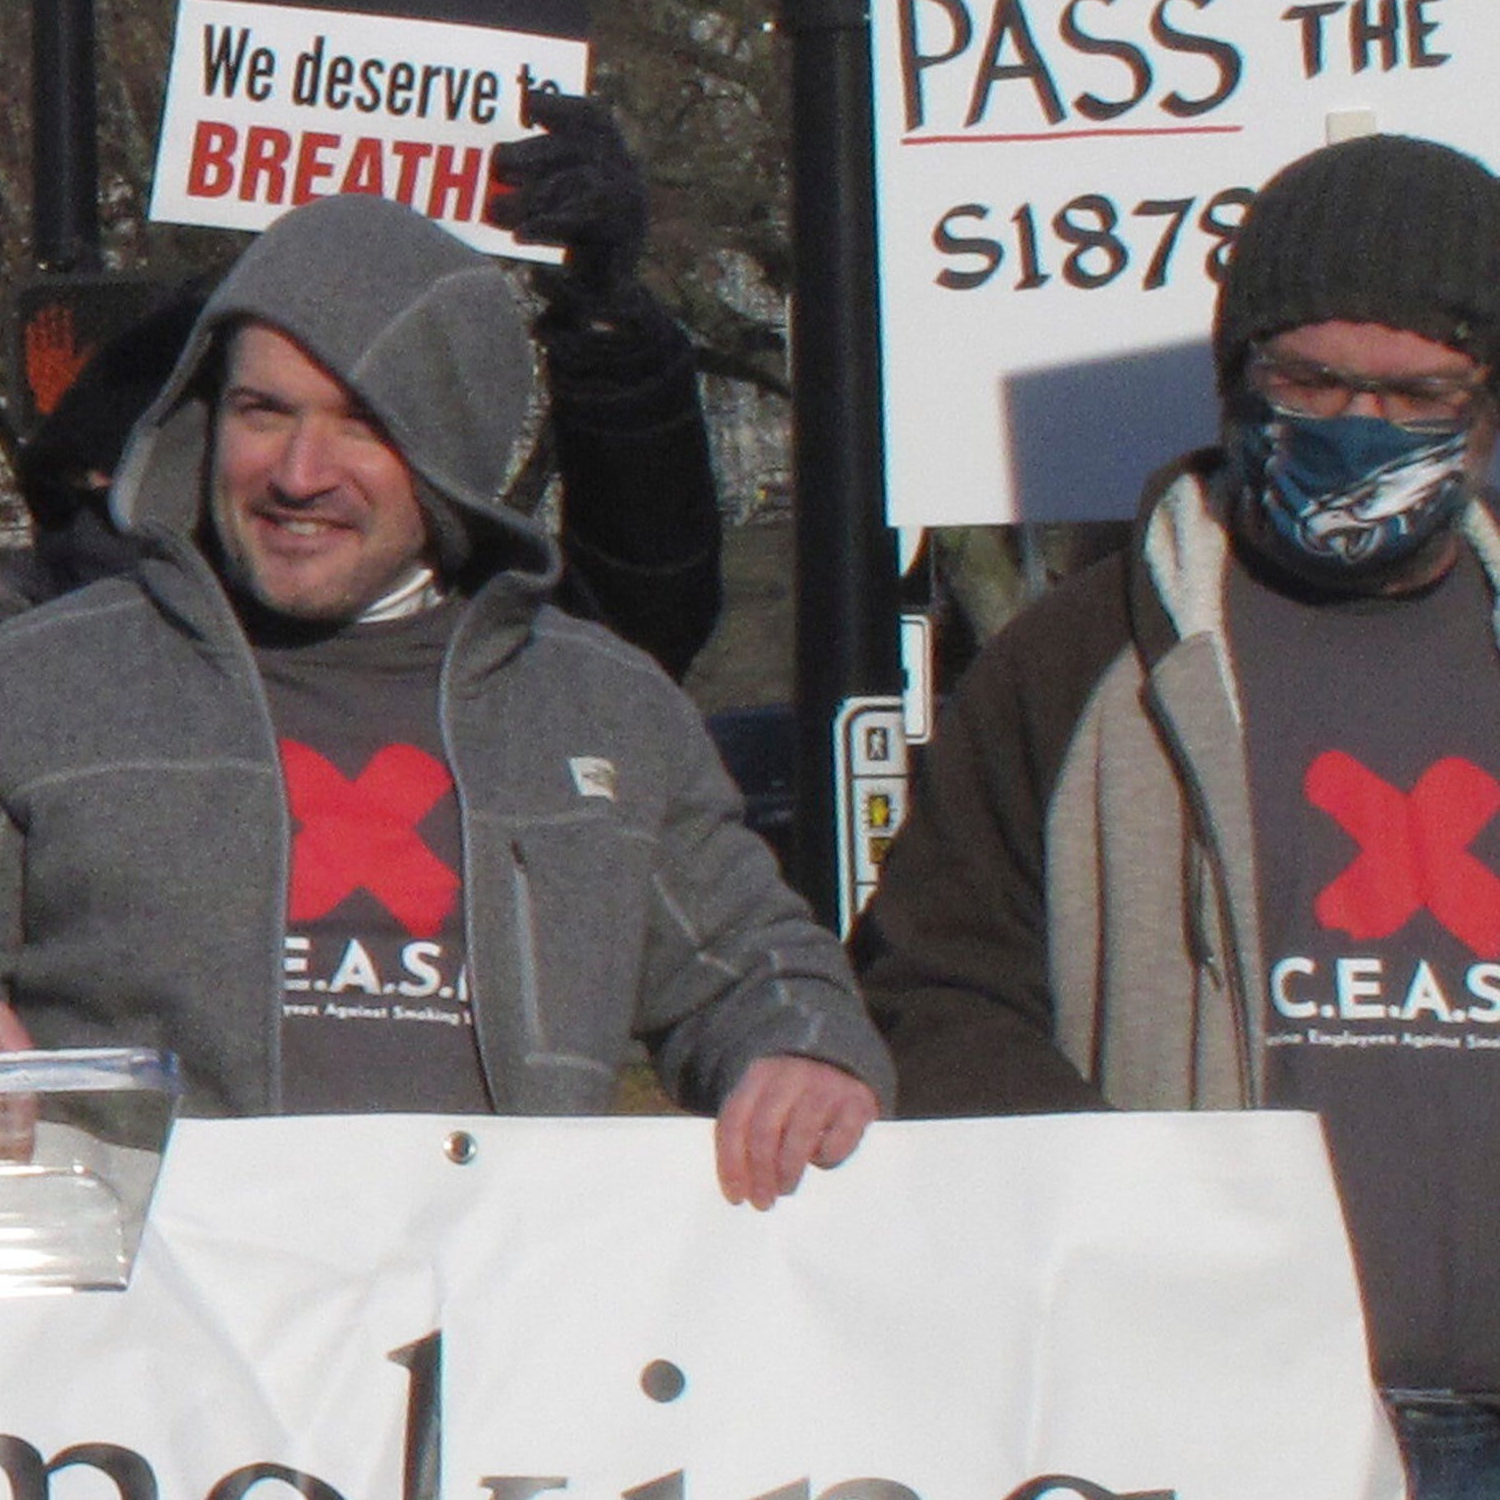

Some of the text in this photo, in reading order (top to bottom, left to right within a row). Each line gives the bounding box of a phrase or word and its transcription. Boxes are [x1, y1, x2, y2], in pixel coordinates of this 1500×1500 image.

[203, 23, 276, 102] We
[291, 35, 499, 126] deserve
[283, 936, 469, 1002] E.A.S.
[1270, 955, 1500, 1024] C.E.A.S
